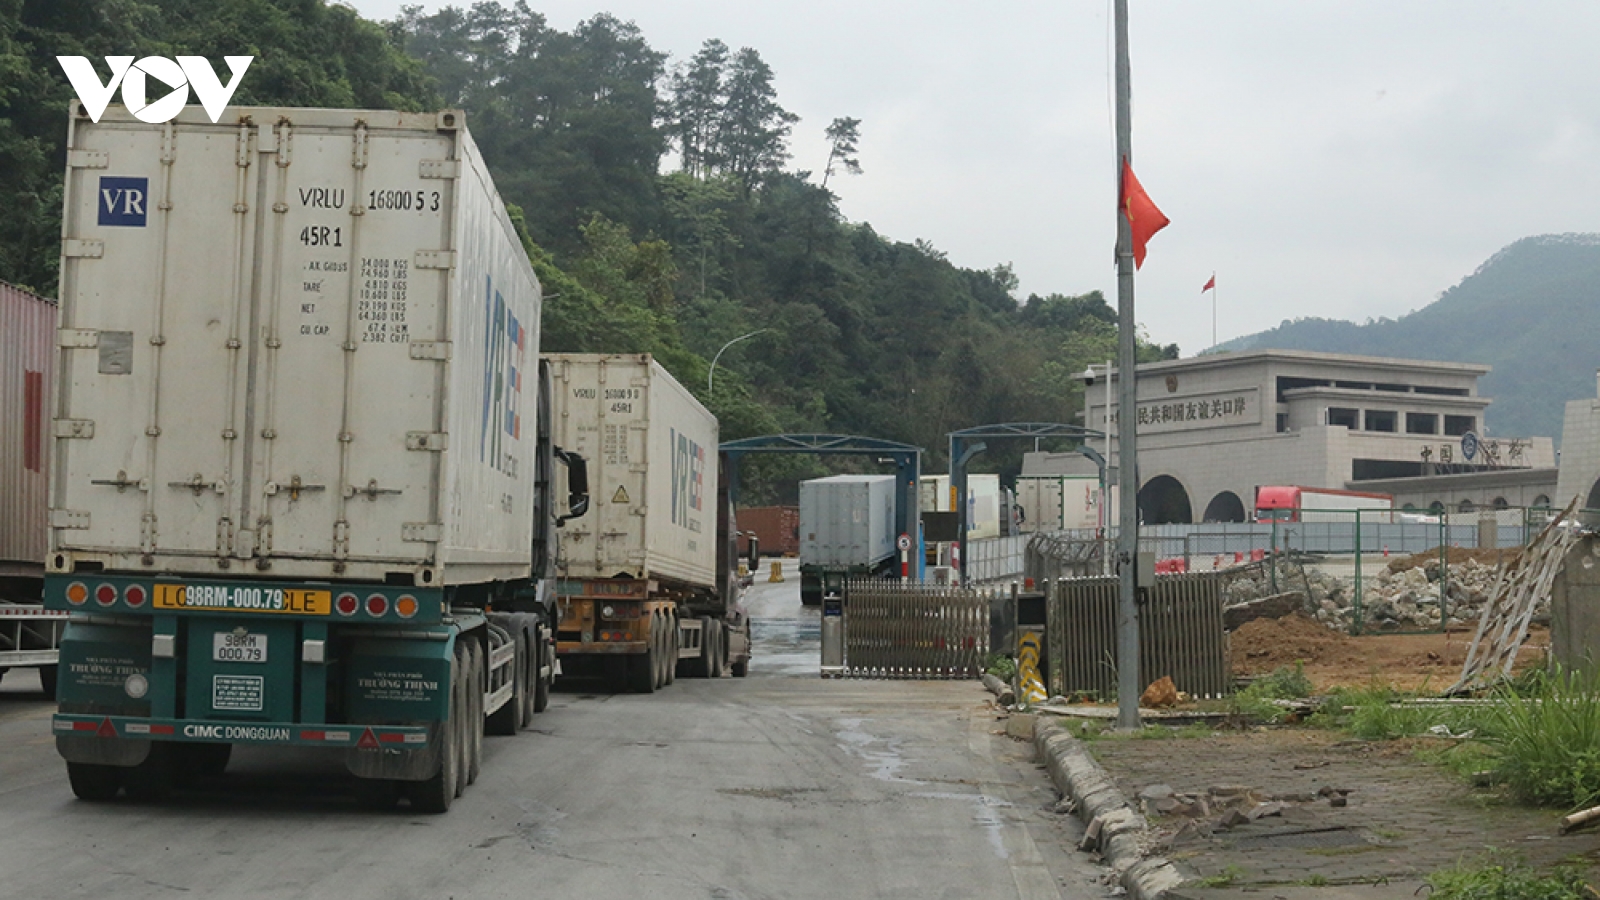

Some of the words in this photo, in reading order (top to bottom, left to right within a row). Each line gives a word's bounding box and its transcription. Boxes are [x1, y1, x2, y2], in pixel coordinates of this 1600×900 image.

[101, 188, 144, 215] VR
[299, 188, 345, 209] VRLU
[430, 191, 441, 212] 3
[303, 282, 321, 293] TARE
[301, 304, 316, 314] NET
[186, 585, 283, 609] 98RM-000.79
[225, 635, 257, 648] 98RM
[218, 647, 262, 660] 000.79
[184, 725, 223, 739] CIMC
[226, 726, 290, 741] DONGGUAN
